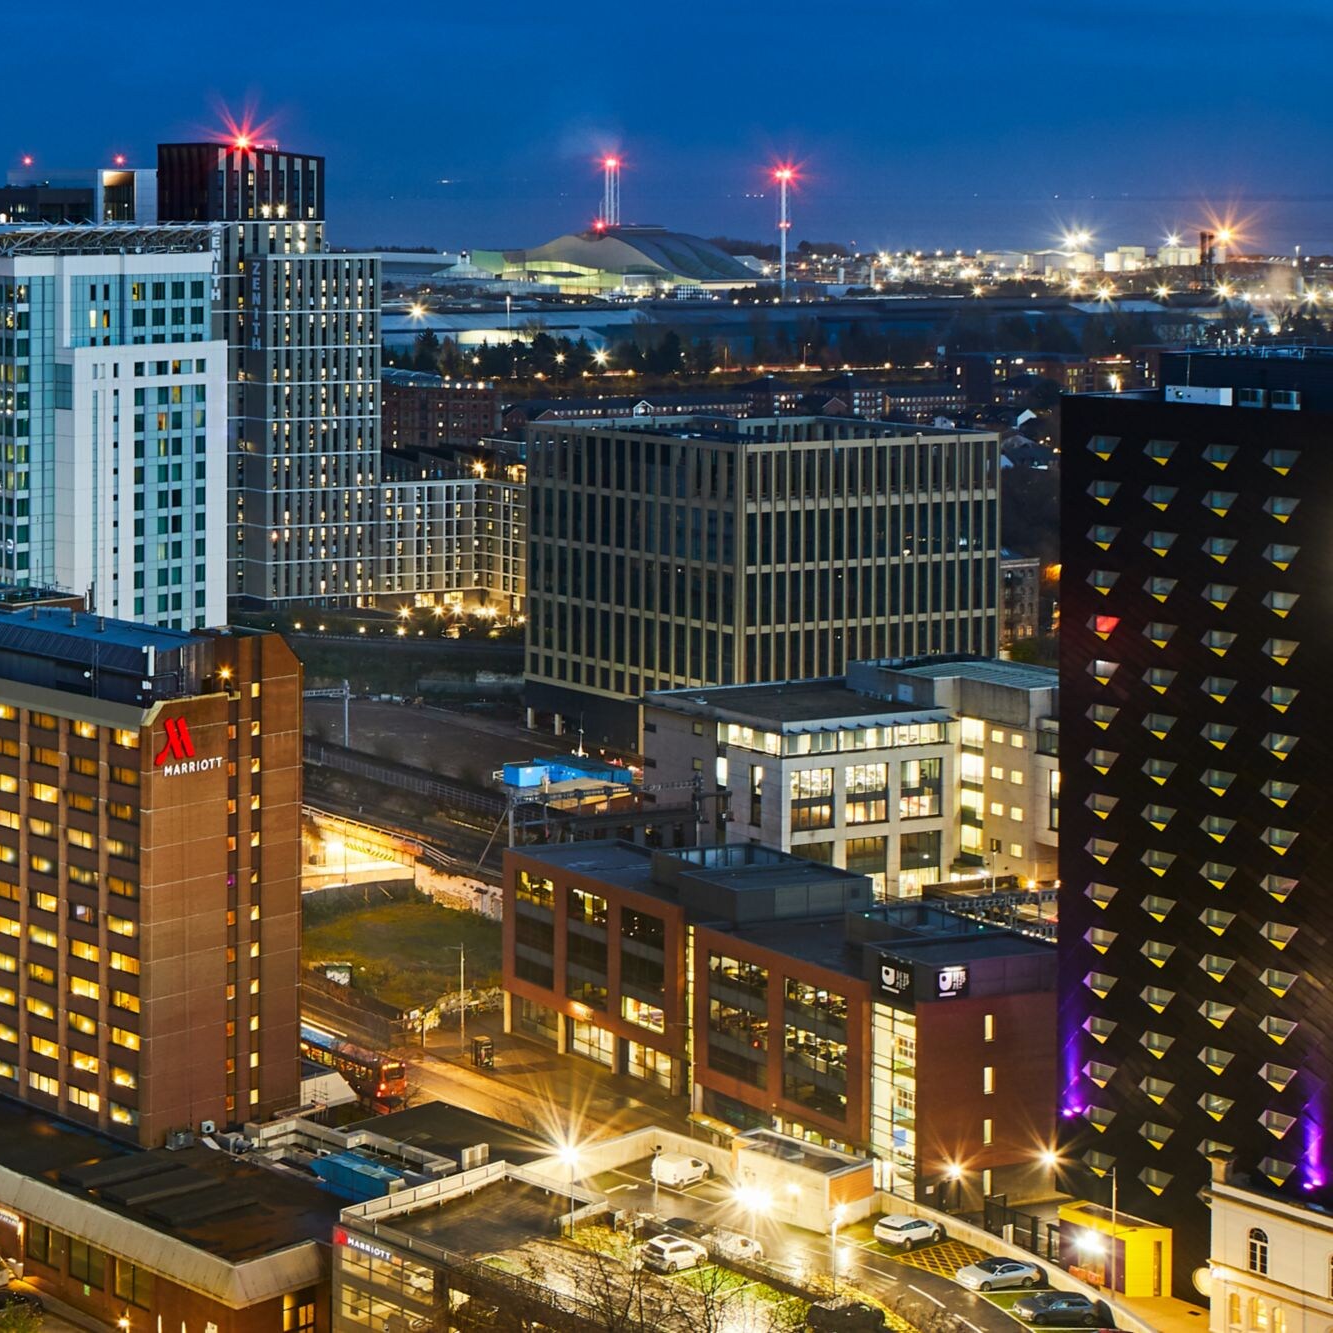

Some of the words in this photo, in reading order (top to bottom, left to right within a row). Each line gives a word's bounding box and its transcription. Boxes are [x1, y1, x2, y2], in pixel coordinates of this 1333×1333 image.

[252, 262, 261, 351] ZENITH
[164, 756, 223, 777] MARRIOTT
[347, 1237, 391, 1260] MARRIOTT
